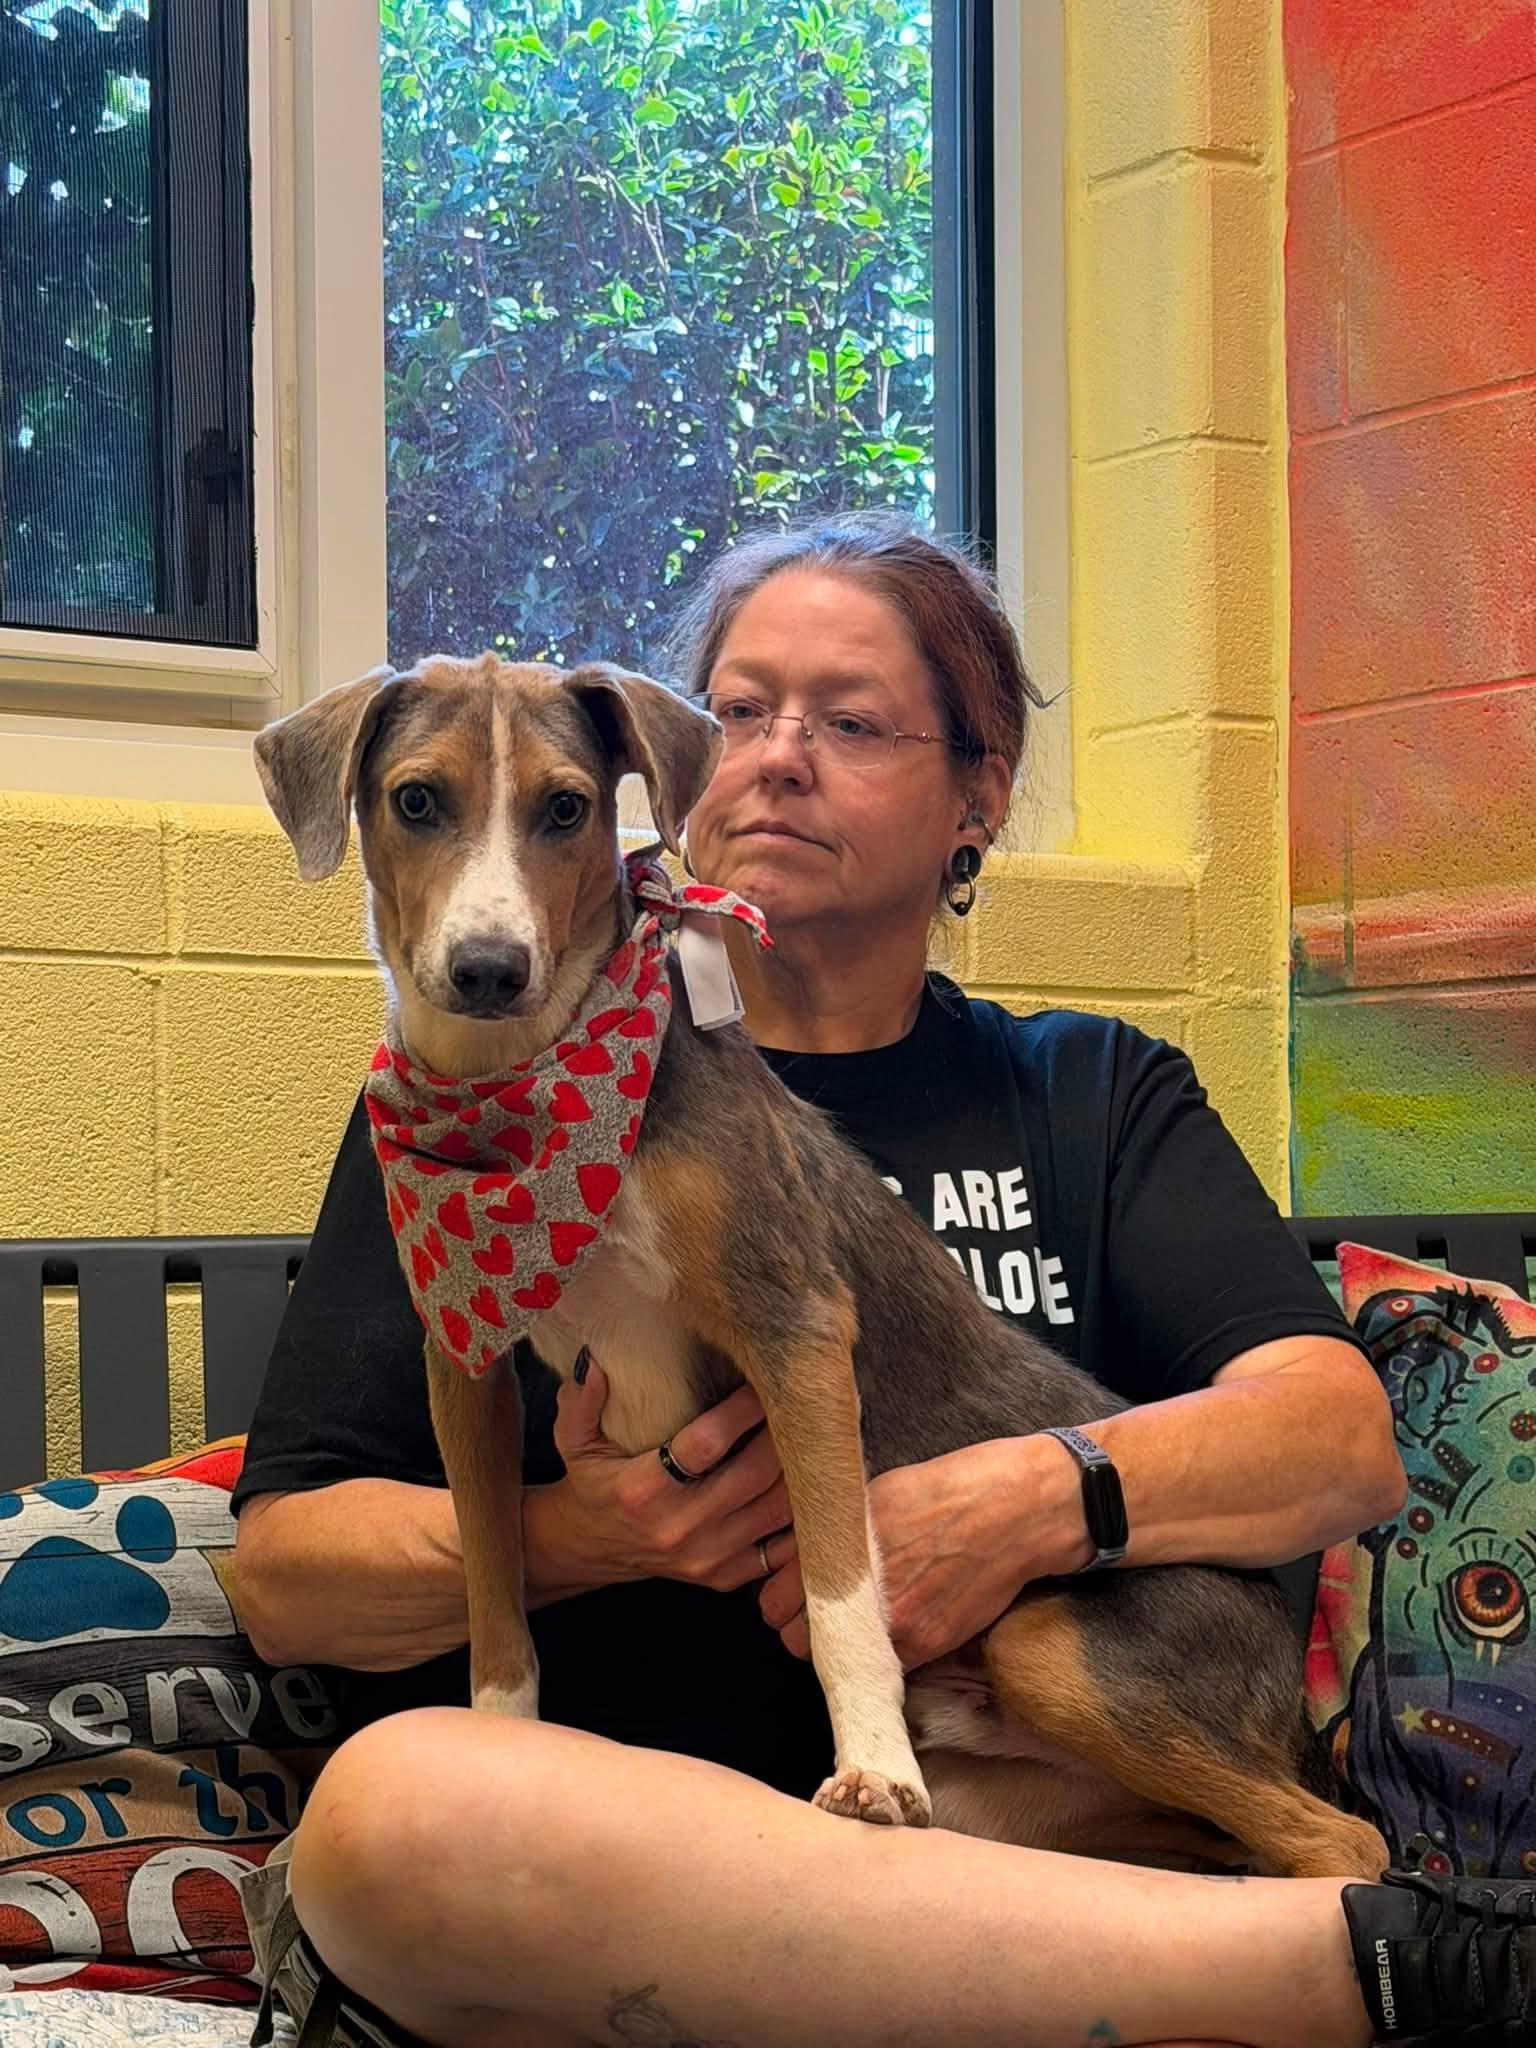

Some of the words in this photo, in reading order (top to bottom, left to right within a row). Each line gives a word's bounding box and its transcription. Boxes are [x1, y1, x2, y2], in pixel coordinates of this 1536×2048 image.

[932, 1166, 1033, 1232] ARE
[946, 1246, 1075, 1325] LOE
[178, 1744, 306, 1836] th
[1375, 1938, 1398, 2030] HOBIBEAR
